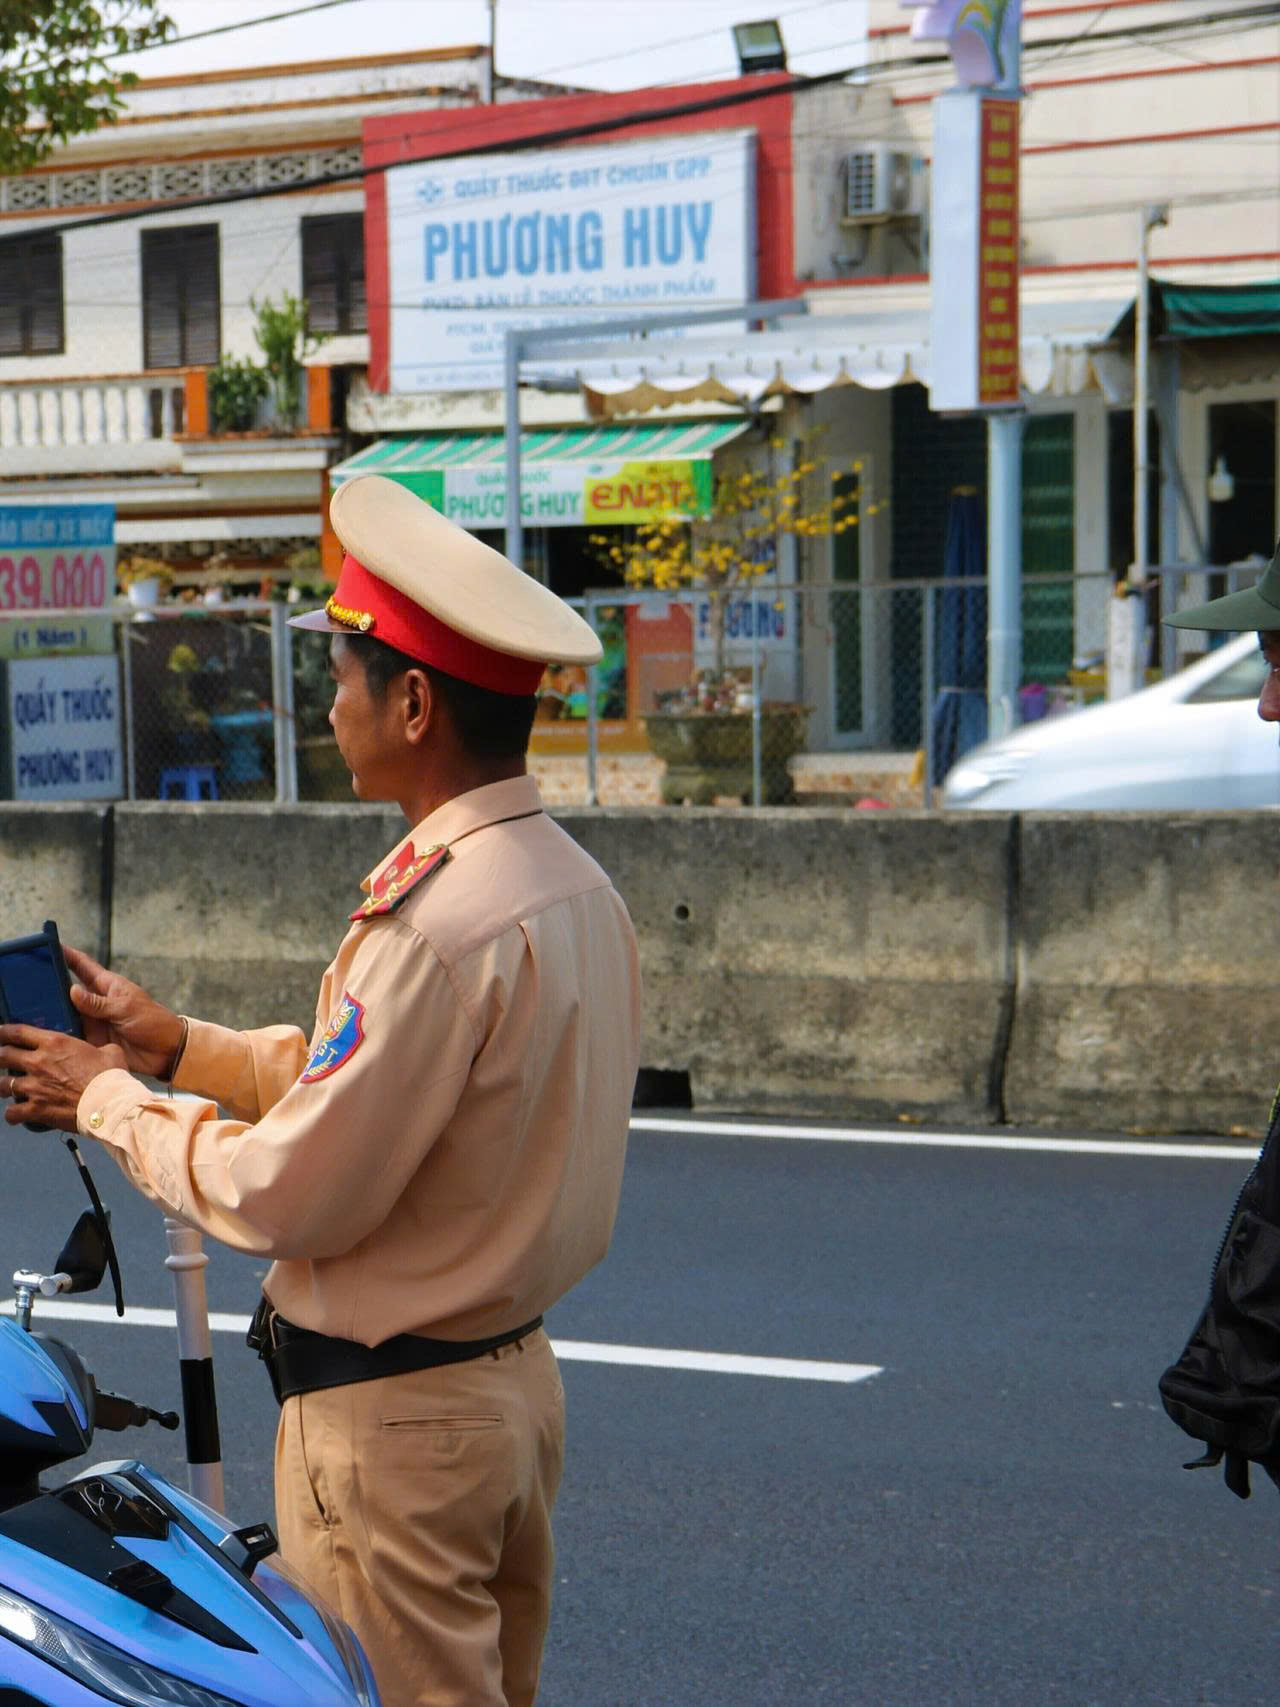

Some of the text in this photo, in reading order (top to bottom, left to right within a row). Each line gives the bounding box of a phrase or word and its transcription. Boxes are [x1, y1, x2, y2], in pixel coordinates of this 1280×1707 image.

[424, 200, 714, 282] PHƯƠNG HUY
[448, 488, 583, 519] PHƯƠG HUY
